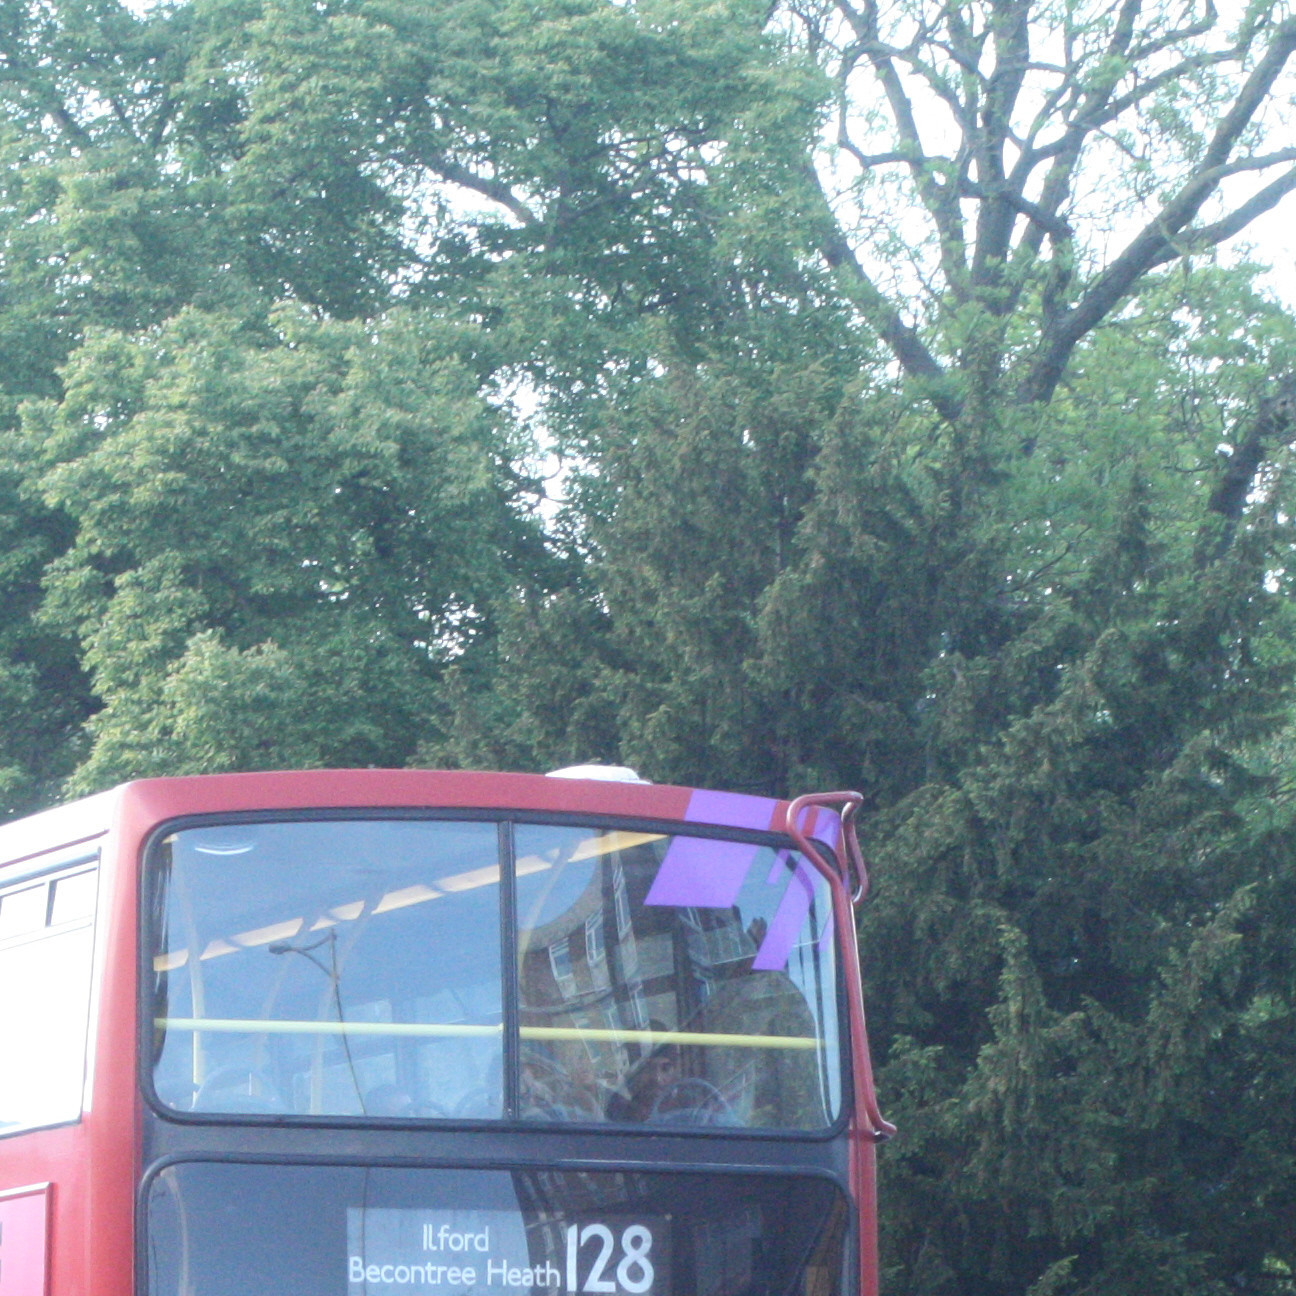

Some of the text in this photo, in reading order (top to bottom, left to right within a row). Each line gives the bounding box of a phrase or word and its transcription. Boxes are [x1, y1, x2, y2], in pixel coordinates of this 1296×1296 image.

[349, 1223, 654, 1294] Becontree Heath 128
[422, 1223, 489, 1252] Ilford
